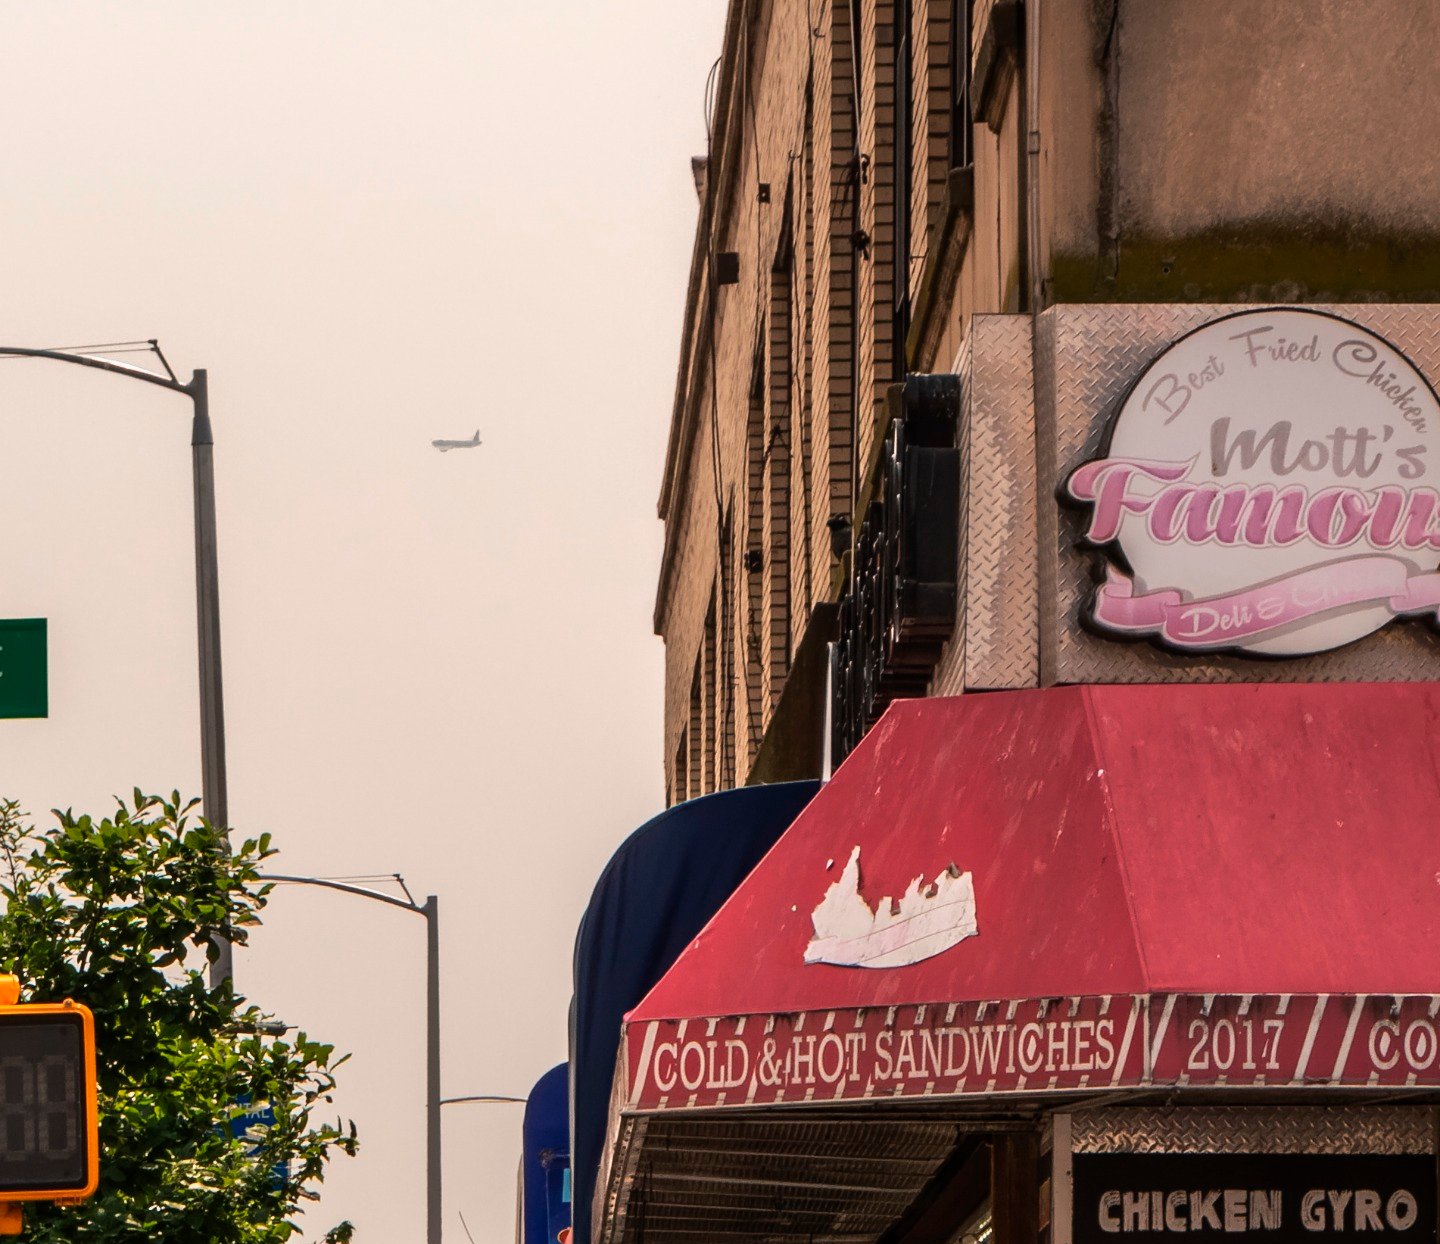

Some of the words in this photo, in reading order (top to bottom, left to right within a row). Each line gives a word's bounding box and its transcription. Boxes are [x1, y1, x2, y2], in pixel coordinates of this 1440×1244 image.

[1141, 353, 1225, 427] Best
[1229, 325, 1321, 368] Fried
[1331, 338, 1429, 436] Chicken
[1209, 416, 1428, 480] Mott's
[1068, 456, 1440, 550] Famou
[1177, 604, 1252, 638] Deli
[653, 1039, 750, 1092] COLD
[759, 1037, 783, 1087] &
[791, 1032, 867, 1084] HOT
[874, 1018, 1115, 1082] SANDWICHES
[1187, 1019, 1286, 1070] 2017
[1367, 1018, 1440, 1071] CO
[1098, 1189, 1283, 1232] CHICKEN
[1300, 1188, 1419, 1232] GYRO
